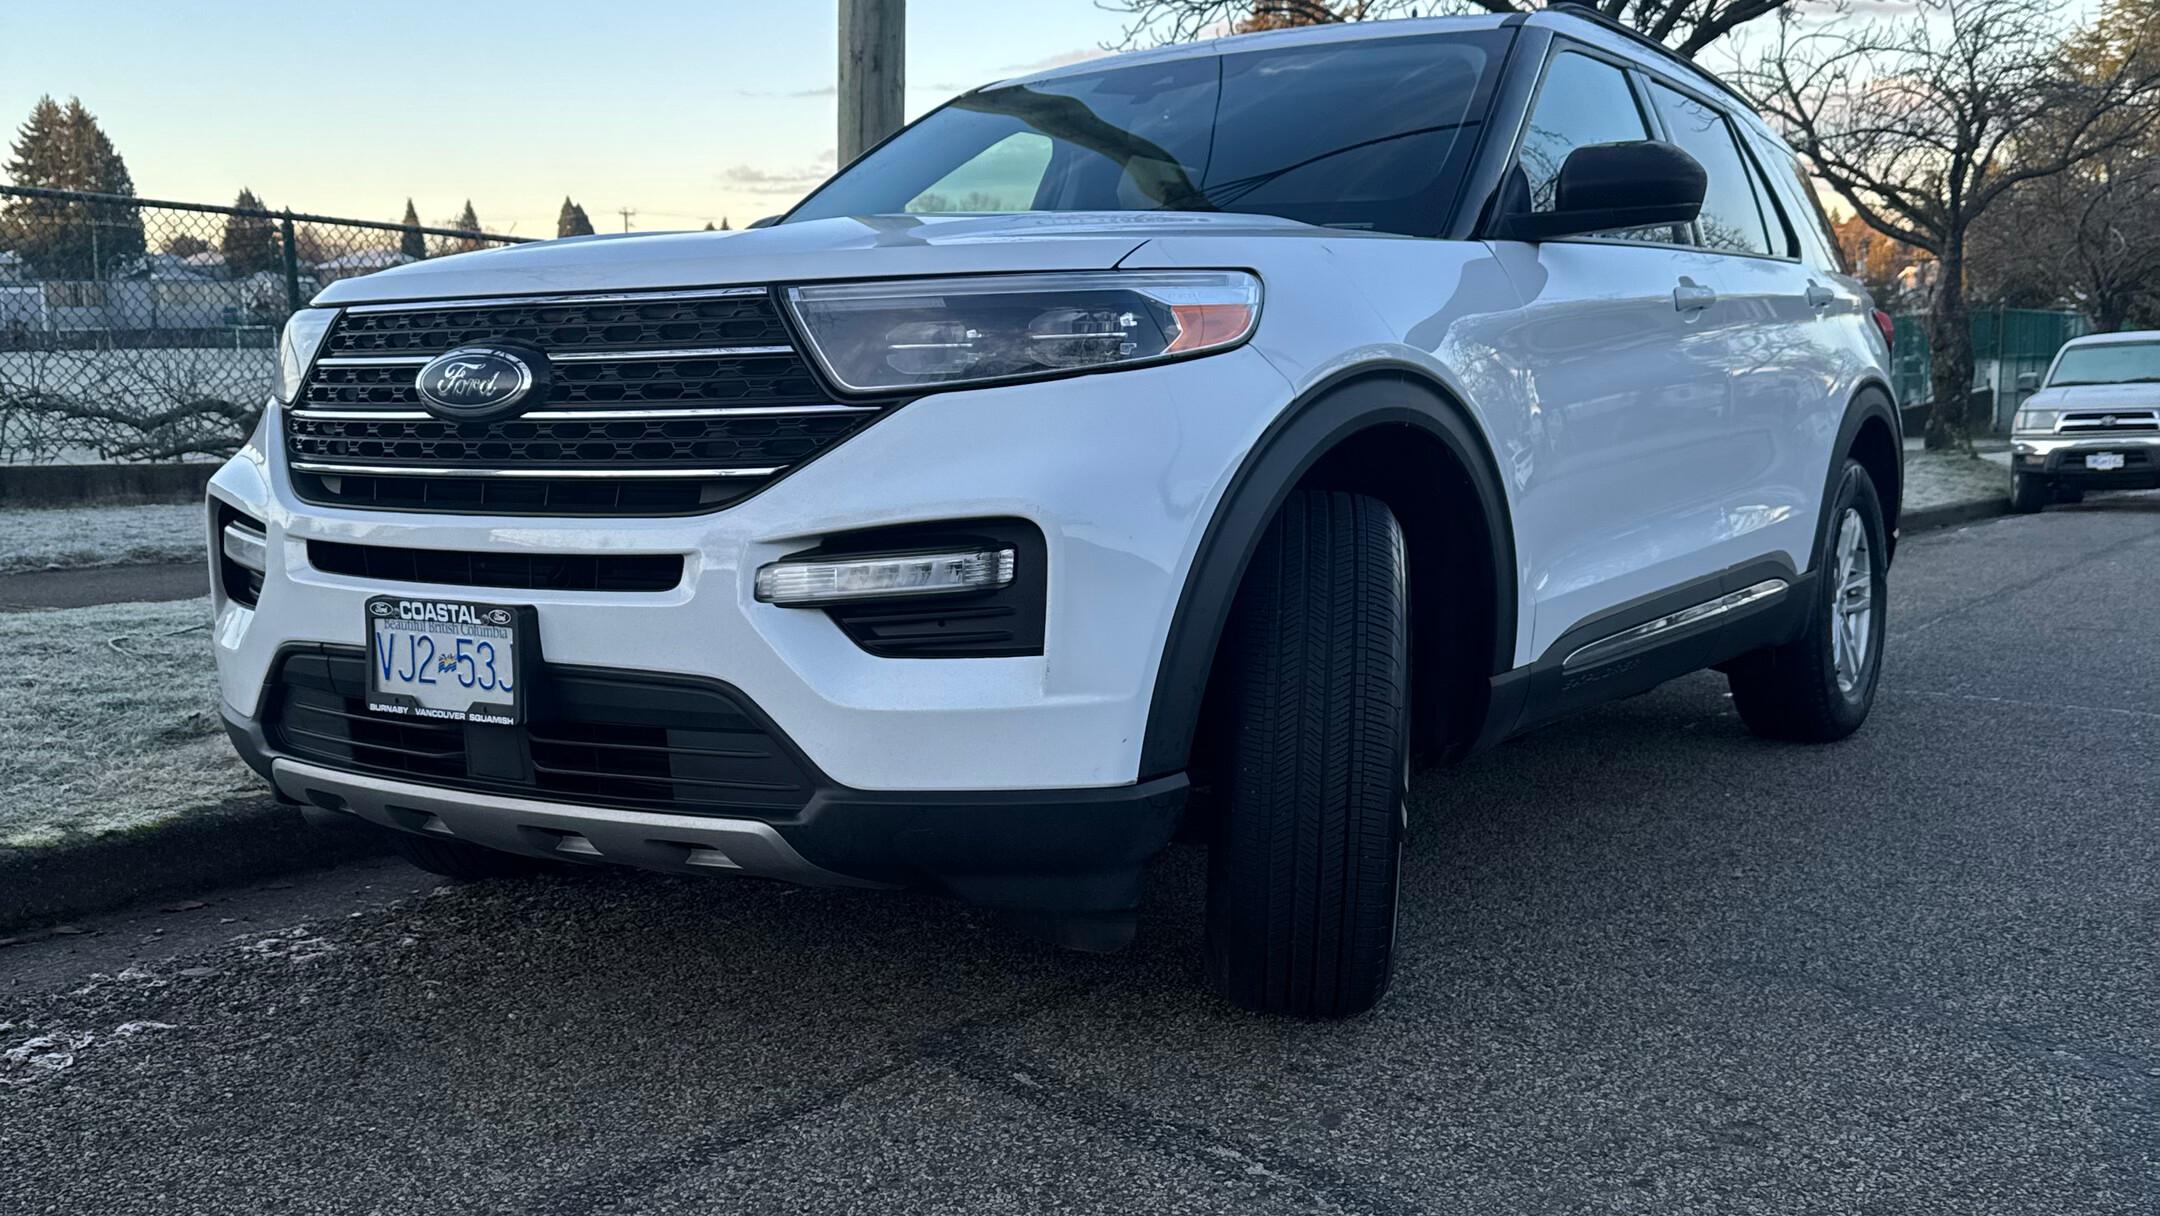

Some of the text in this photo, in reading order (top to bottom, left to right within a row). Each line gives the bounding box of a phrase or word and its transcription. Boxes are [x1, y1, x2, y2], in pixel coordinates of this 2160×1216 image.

[437, 362, 500, 396] Ford
[399, 601, 482, 625] COASTAL
[384, 619, 508, 639] Beautiful British Columbia
[376, 632, 437, 684] VJ2
[369, 703, 514, 725] BURNABY VANCOUVER SQUAMISH
